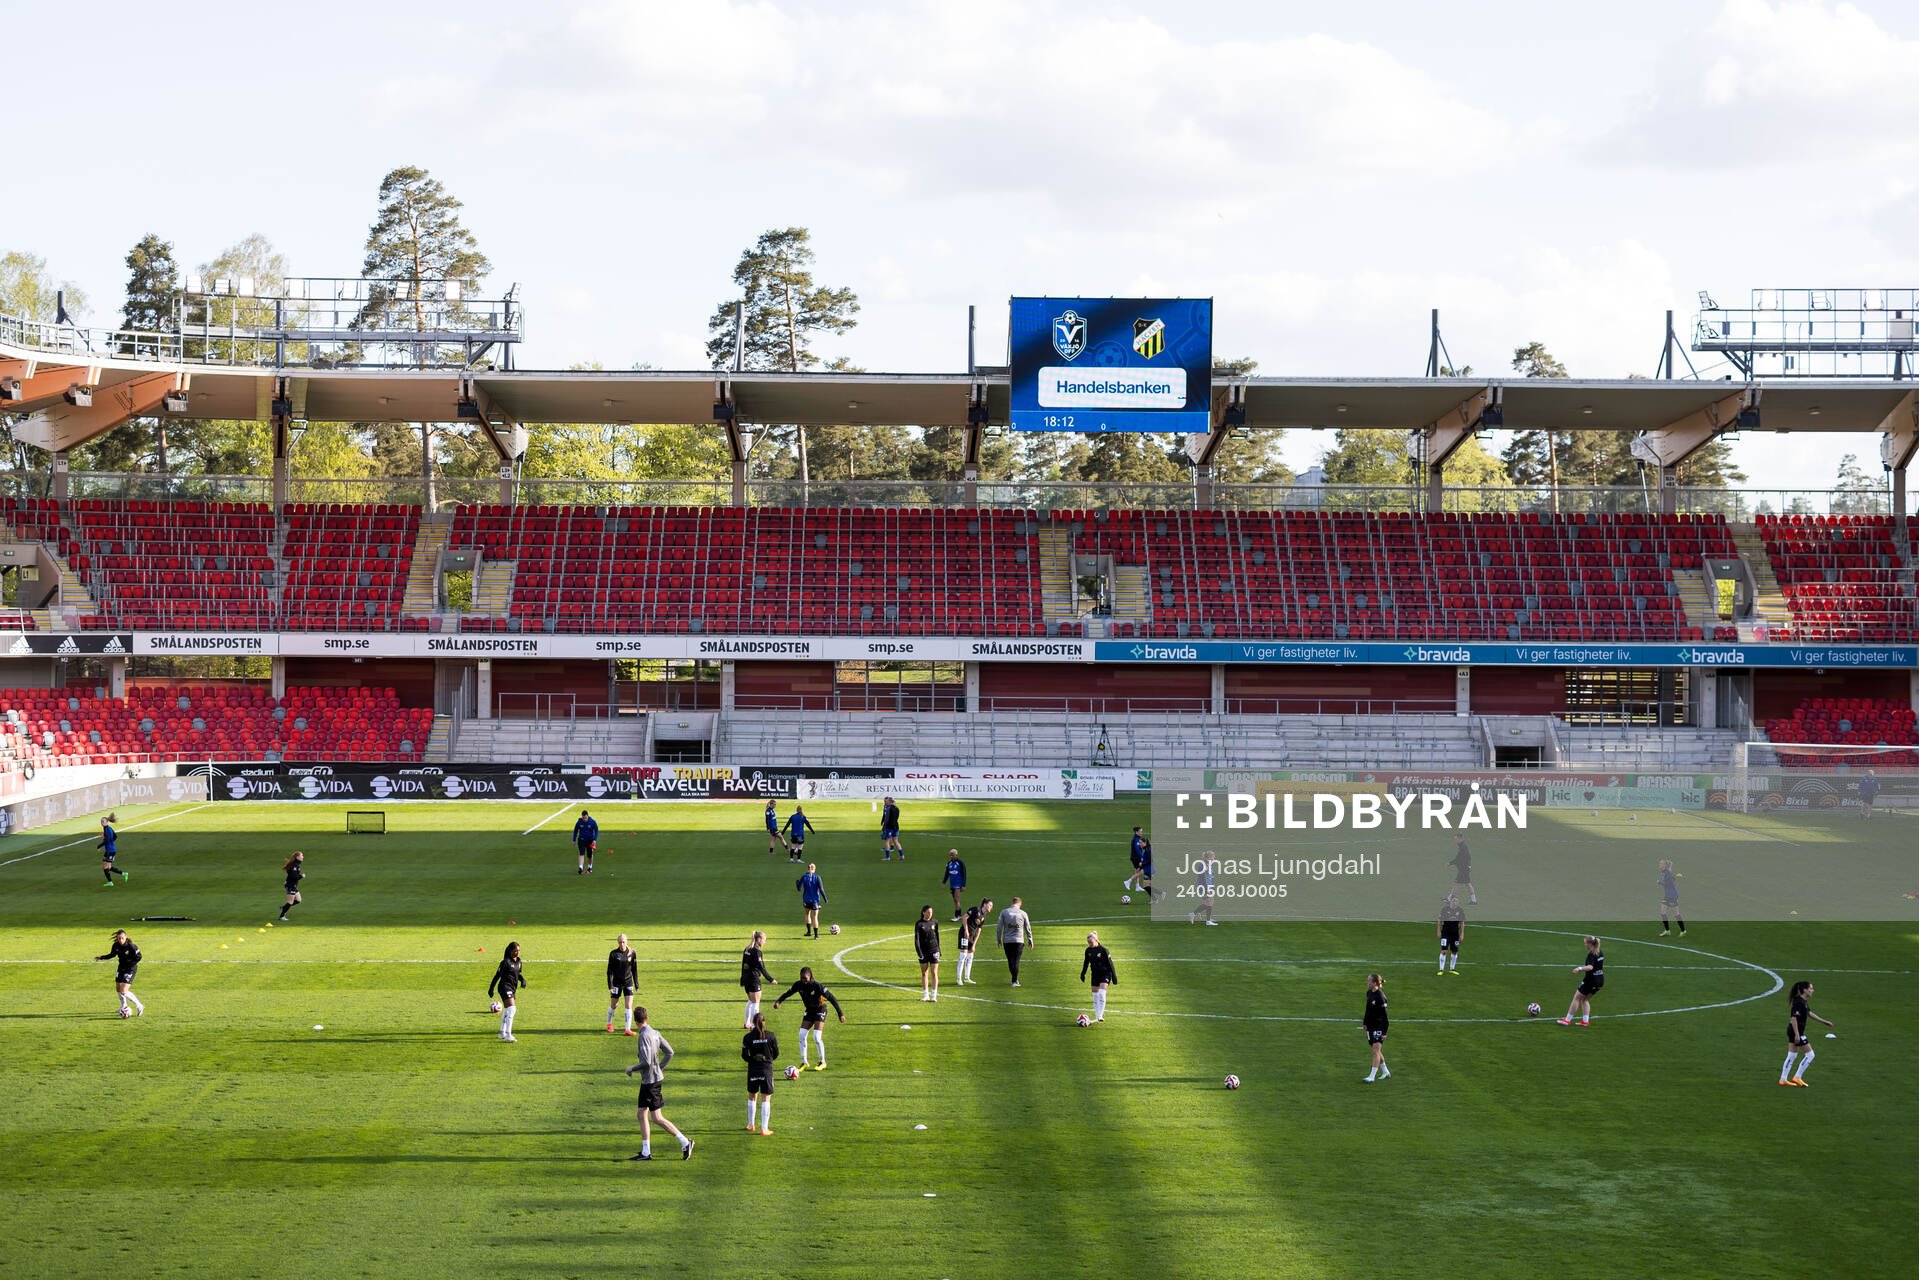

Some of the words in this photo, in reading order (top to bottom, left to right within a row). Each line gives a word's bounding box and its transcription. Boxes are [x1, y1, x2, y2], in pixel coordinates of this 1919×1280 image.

[1057, 380, 1171, 394] Handelsbanken
[1043, 416, 1075, 428] 18:12
[150, 634, 262, 649] SMÅLANDSPOSTEN
[324, 638, 370, 651] smp.se
[428, 637, 538, 651] SMÅLANDSPOSTEN
[595, 640, 641, 653] smp.se
[699, 639, 810, 653] SMÅLANDSPOSTEN
[868, 642, 914, 655] smp.se
[972, 641, 1082, 656] SMÅLANDSPOSTEN
[1145, 644, 1197, 660] bravida
[1243, 646, 1254, 657] Vi
[1257, 649, 1275, 660] ger
[1280, 646, 1340, 660] fastigheter
[1343, 647, 1358, 658] liv.
[1418, 646, 1471, 662] bravida
[1516, 648, 1528, 660] Vi
[1530, 651, 1549, 662] ger
[1553, 648, 1614, 662] fastigheter
[1617, 649, 1632, 660] liv.
[1692, 648, 1744, 664] bravida
[1790, 650, 1802, 661] Vi
[1805, 653, 1824, 664] ger
[1828, 650, 1889, 664] fastigheter
[1892, 650, 1907, 662] liv.
[126, 784, 154, 797] VIDA
[248, 780, 282, 793] VIDA
[318, 779, 353, 793] VIDA
[391, 779, 425, 793] VIDA
[462, 779, 496, 793] VIDA
[533, 779, 568, 793] VIDA
[643, 779, 710, 792] RAVELLI
[723, 779, 789, 792] RAVELLI
[866, 784, 935, 793] RESTAURANG
[939, 784, 982, 793] HOTELL
[987, 784, 1046, 793] KONDITORI
